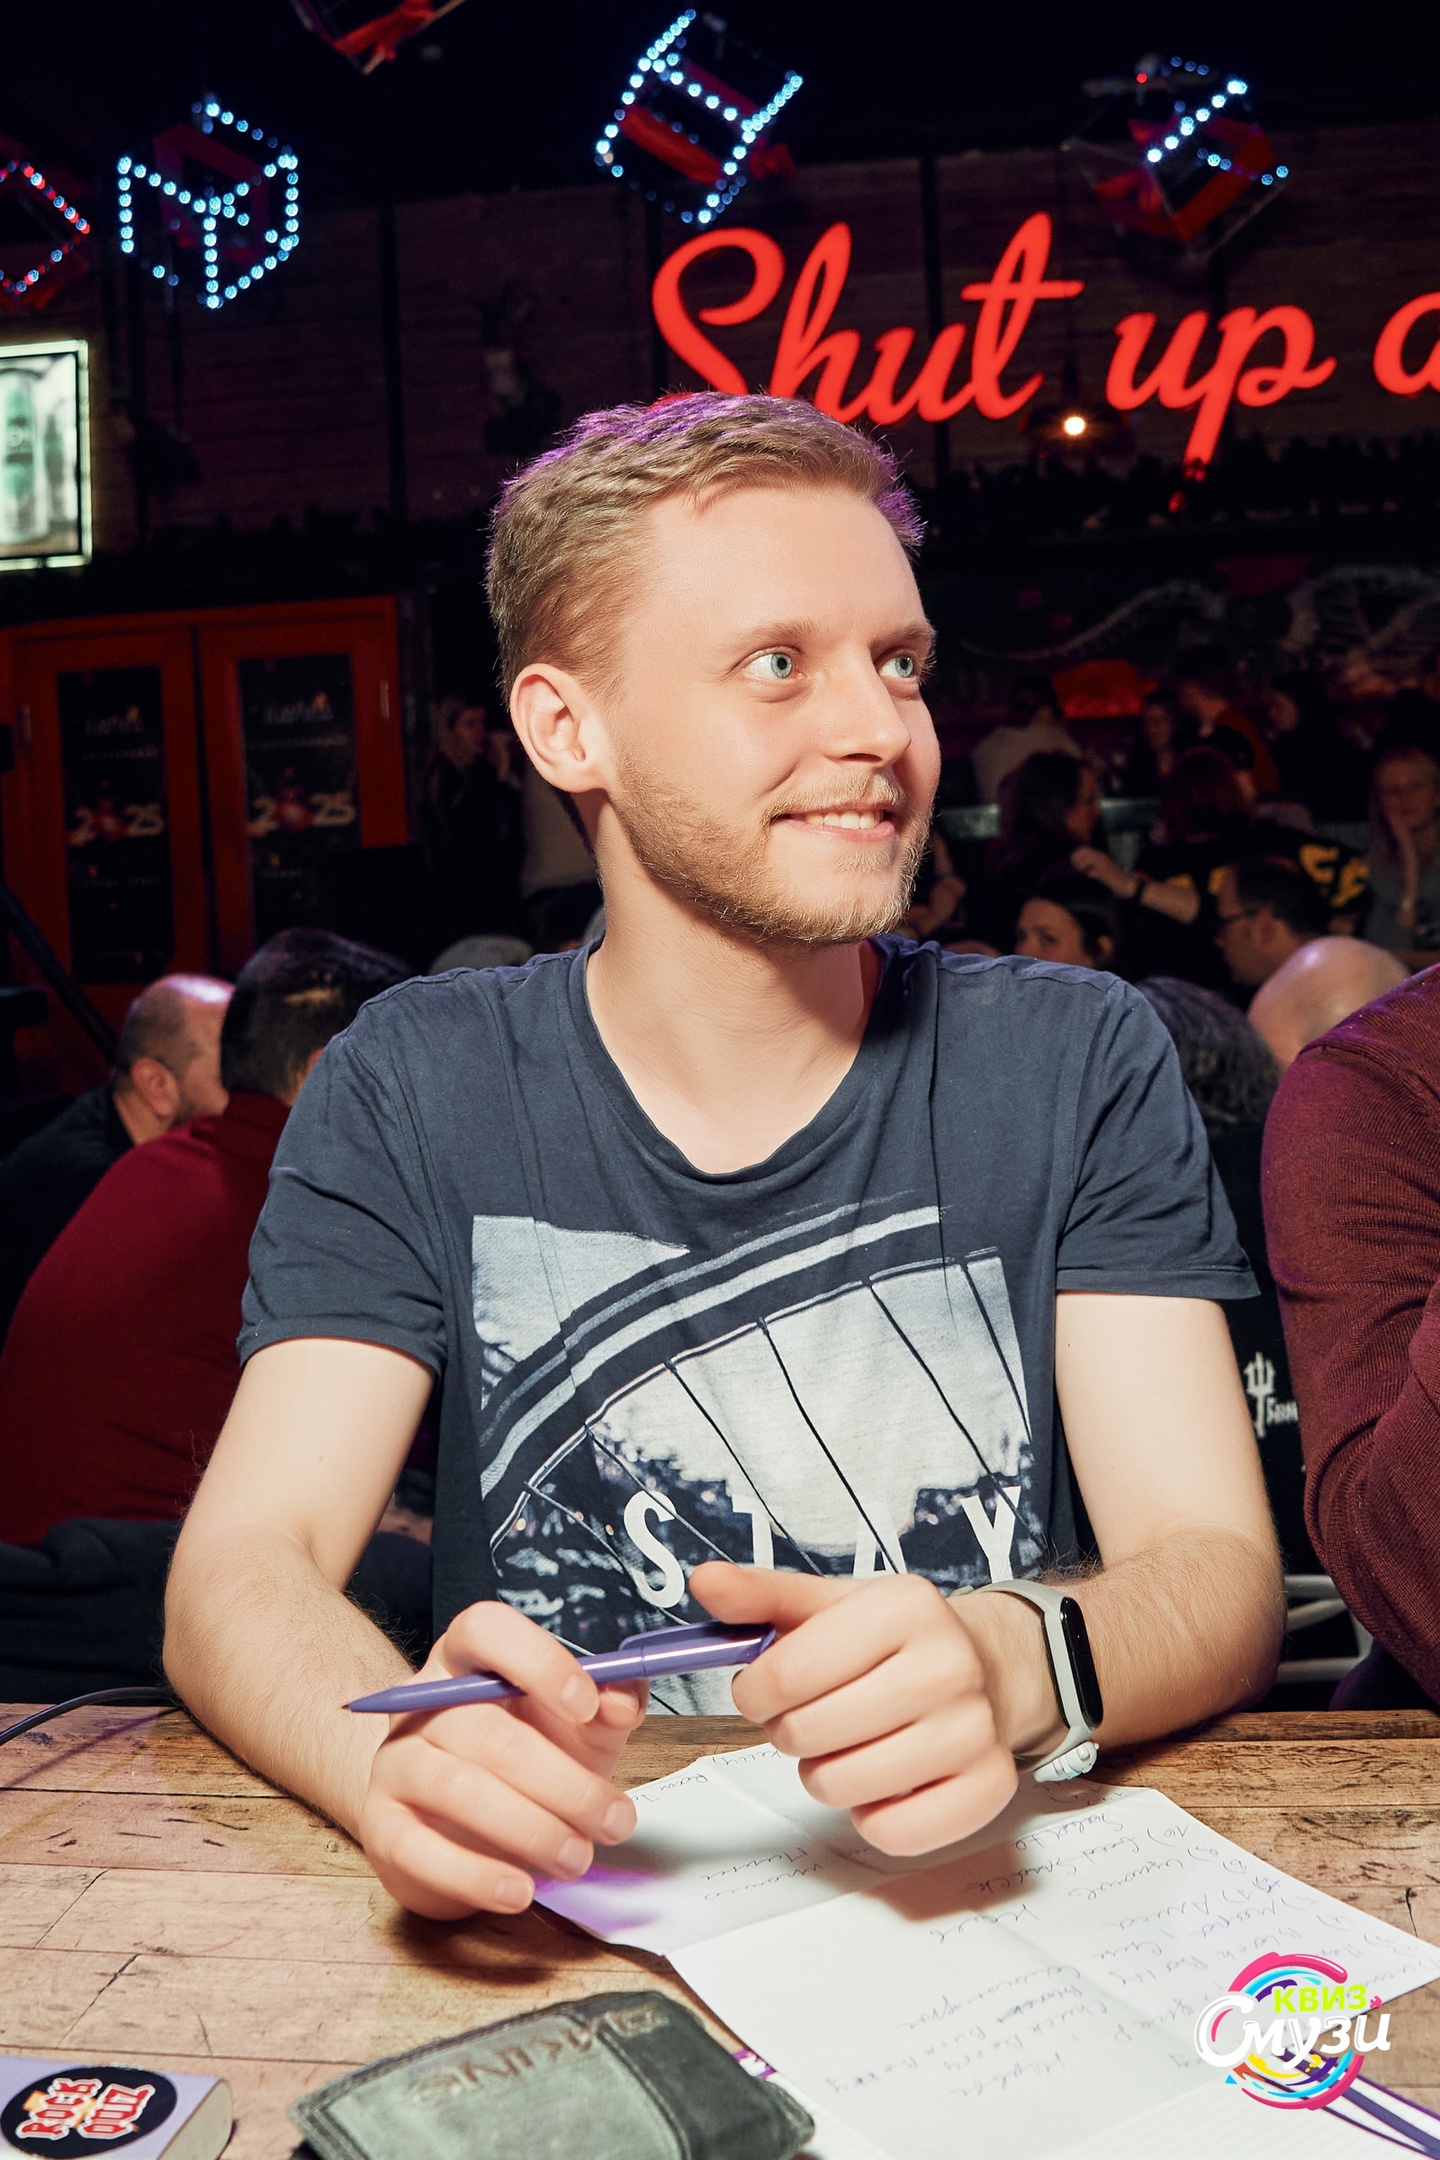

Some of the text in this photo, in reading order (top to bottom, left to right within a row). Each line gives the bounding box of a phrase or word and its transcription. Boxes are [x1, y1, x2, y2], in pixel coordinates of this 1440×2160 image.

[653, 211, 1085, 425] Shut
[1106, 305, 1336, 464] up
[623, 1486, 1022, 1609] STAY
[15, 2078, 156, 2141] ROCK QUIZ
